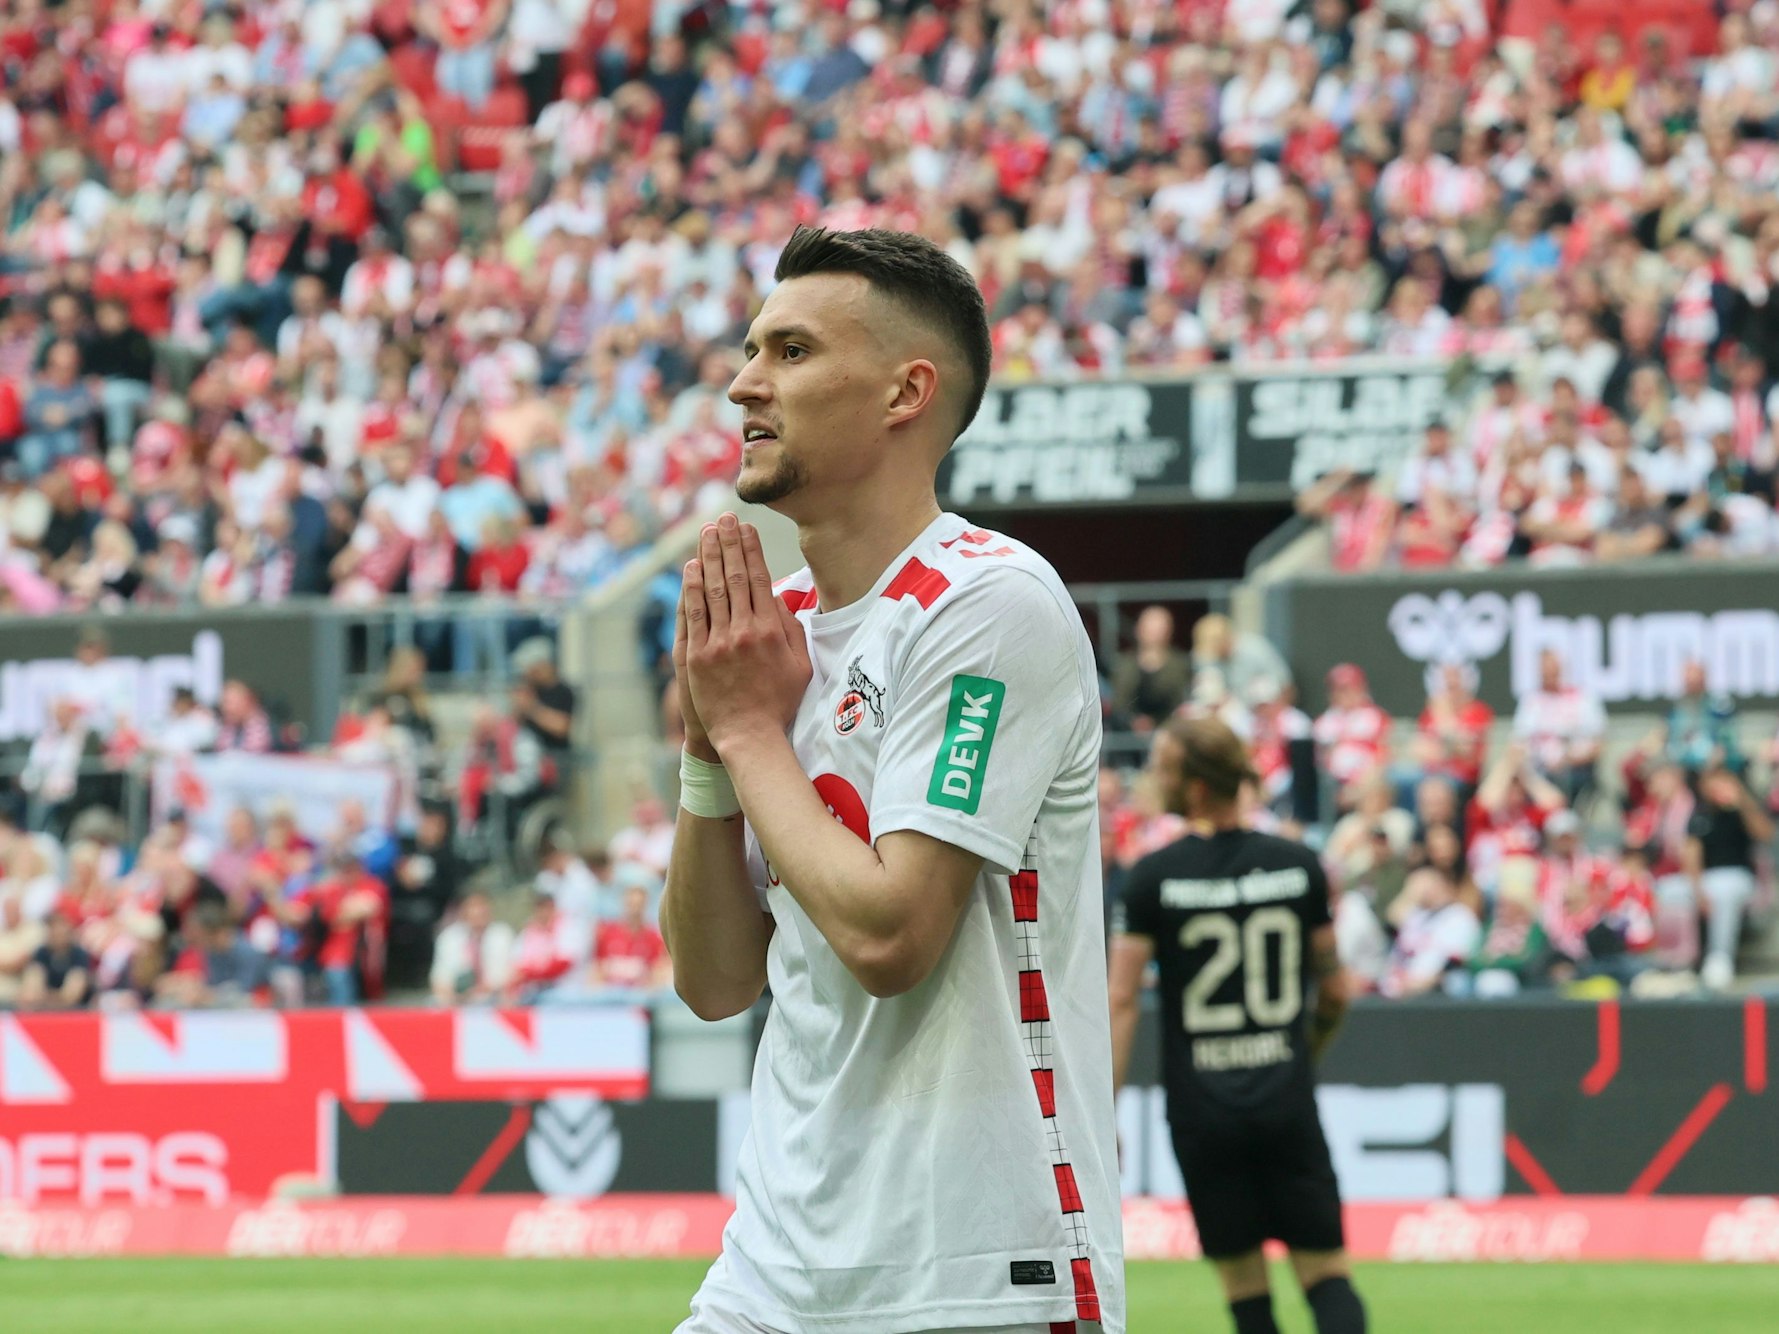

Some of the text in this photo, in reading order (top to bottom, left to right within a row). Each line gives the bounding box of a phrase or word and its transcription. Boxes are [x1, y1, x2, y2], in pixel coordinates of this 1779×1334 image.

[941, 689, 993, 800] DEVK
[1178, 905, 1302, 1034] 20
[0, 1131, 230, 1208] ERS
